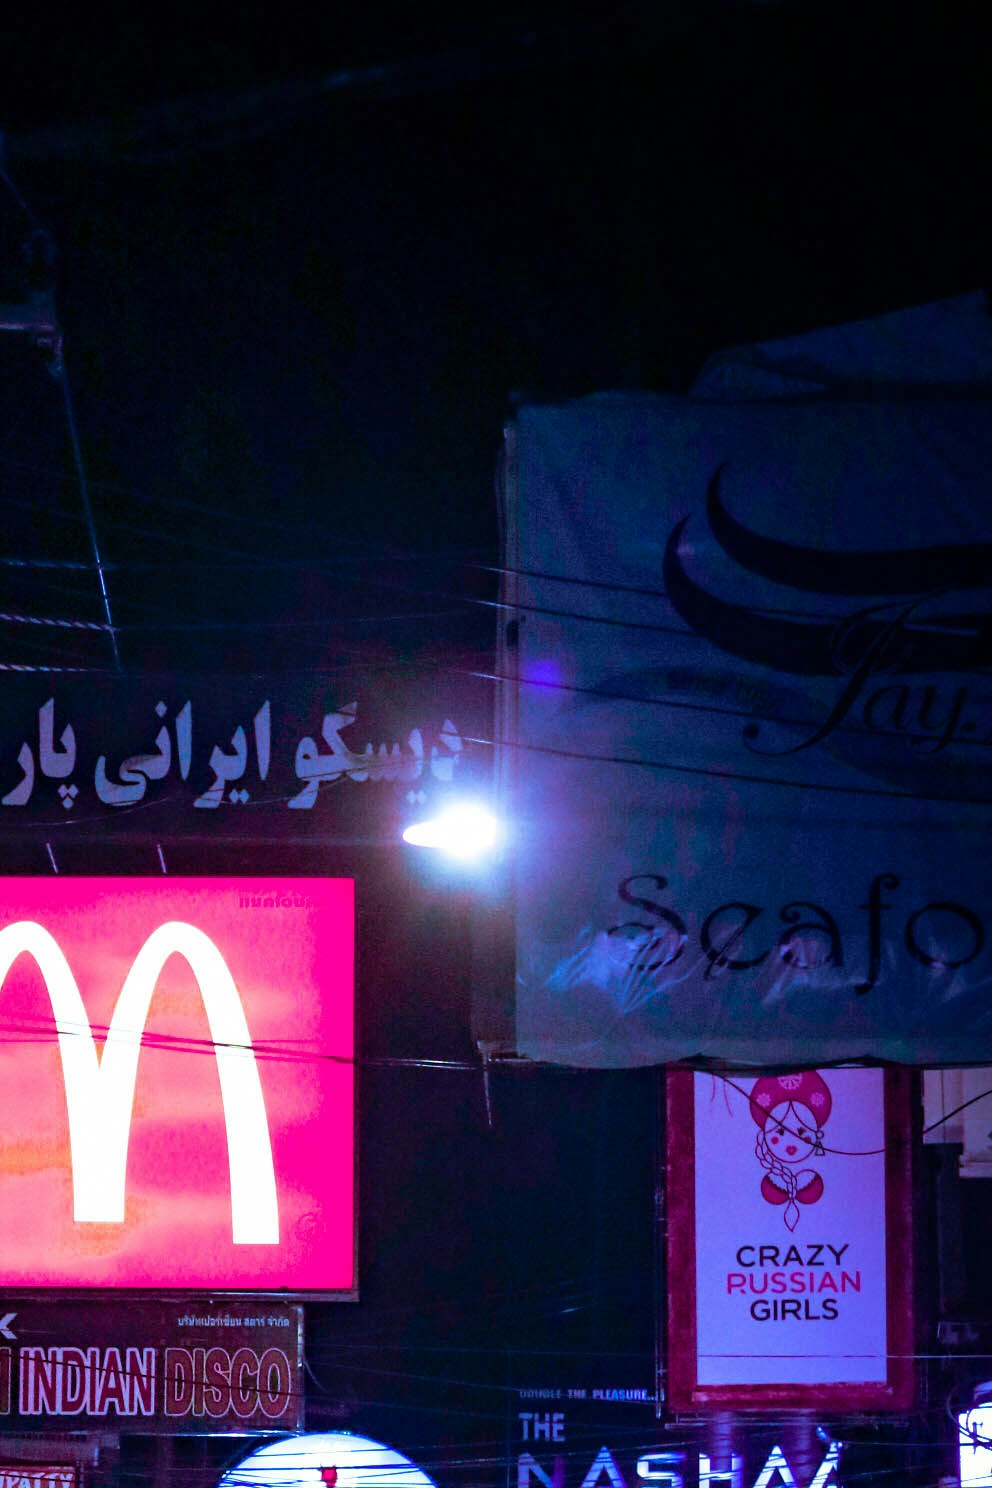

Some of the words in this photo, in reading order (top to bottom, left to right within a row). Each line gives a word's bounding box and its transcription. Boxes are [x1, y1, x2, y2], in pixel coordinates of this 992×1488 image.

[736, 1244, 849, 1267] CRAZY
[726, 1271, 861, 1295] RUSSIAN
[750, 1300, 839, 1321] GIRLS
[19, 1346, 156, 1416] INDIAN
[164, 1347, 292, 1418] DISCO
[519, 1413, 565, 1442] THE
